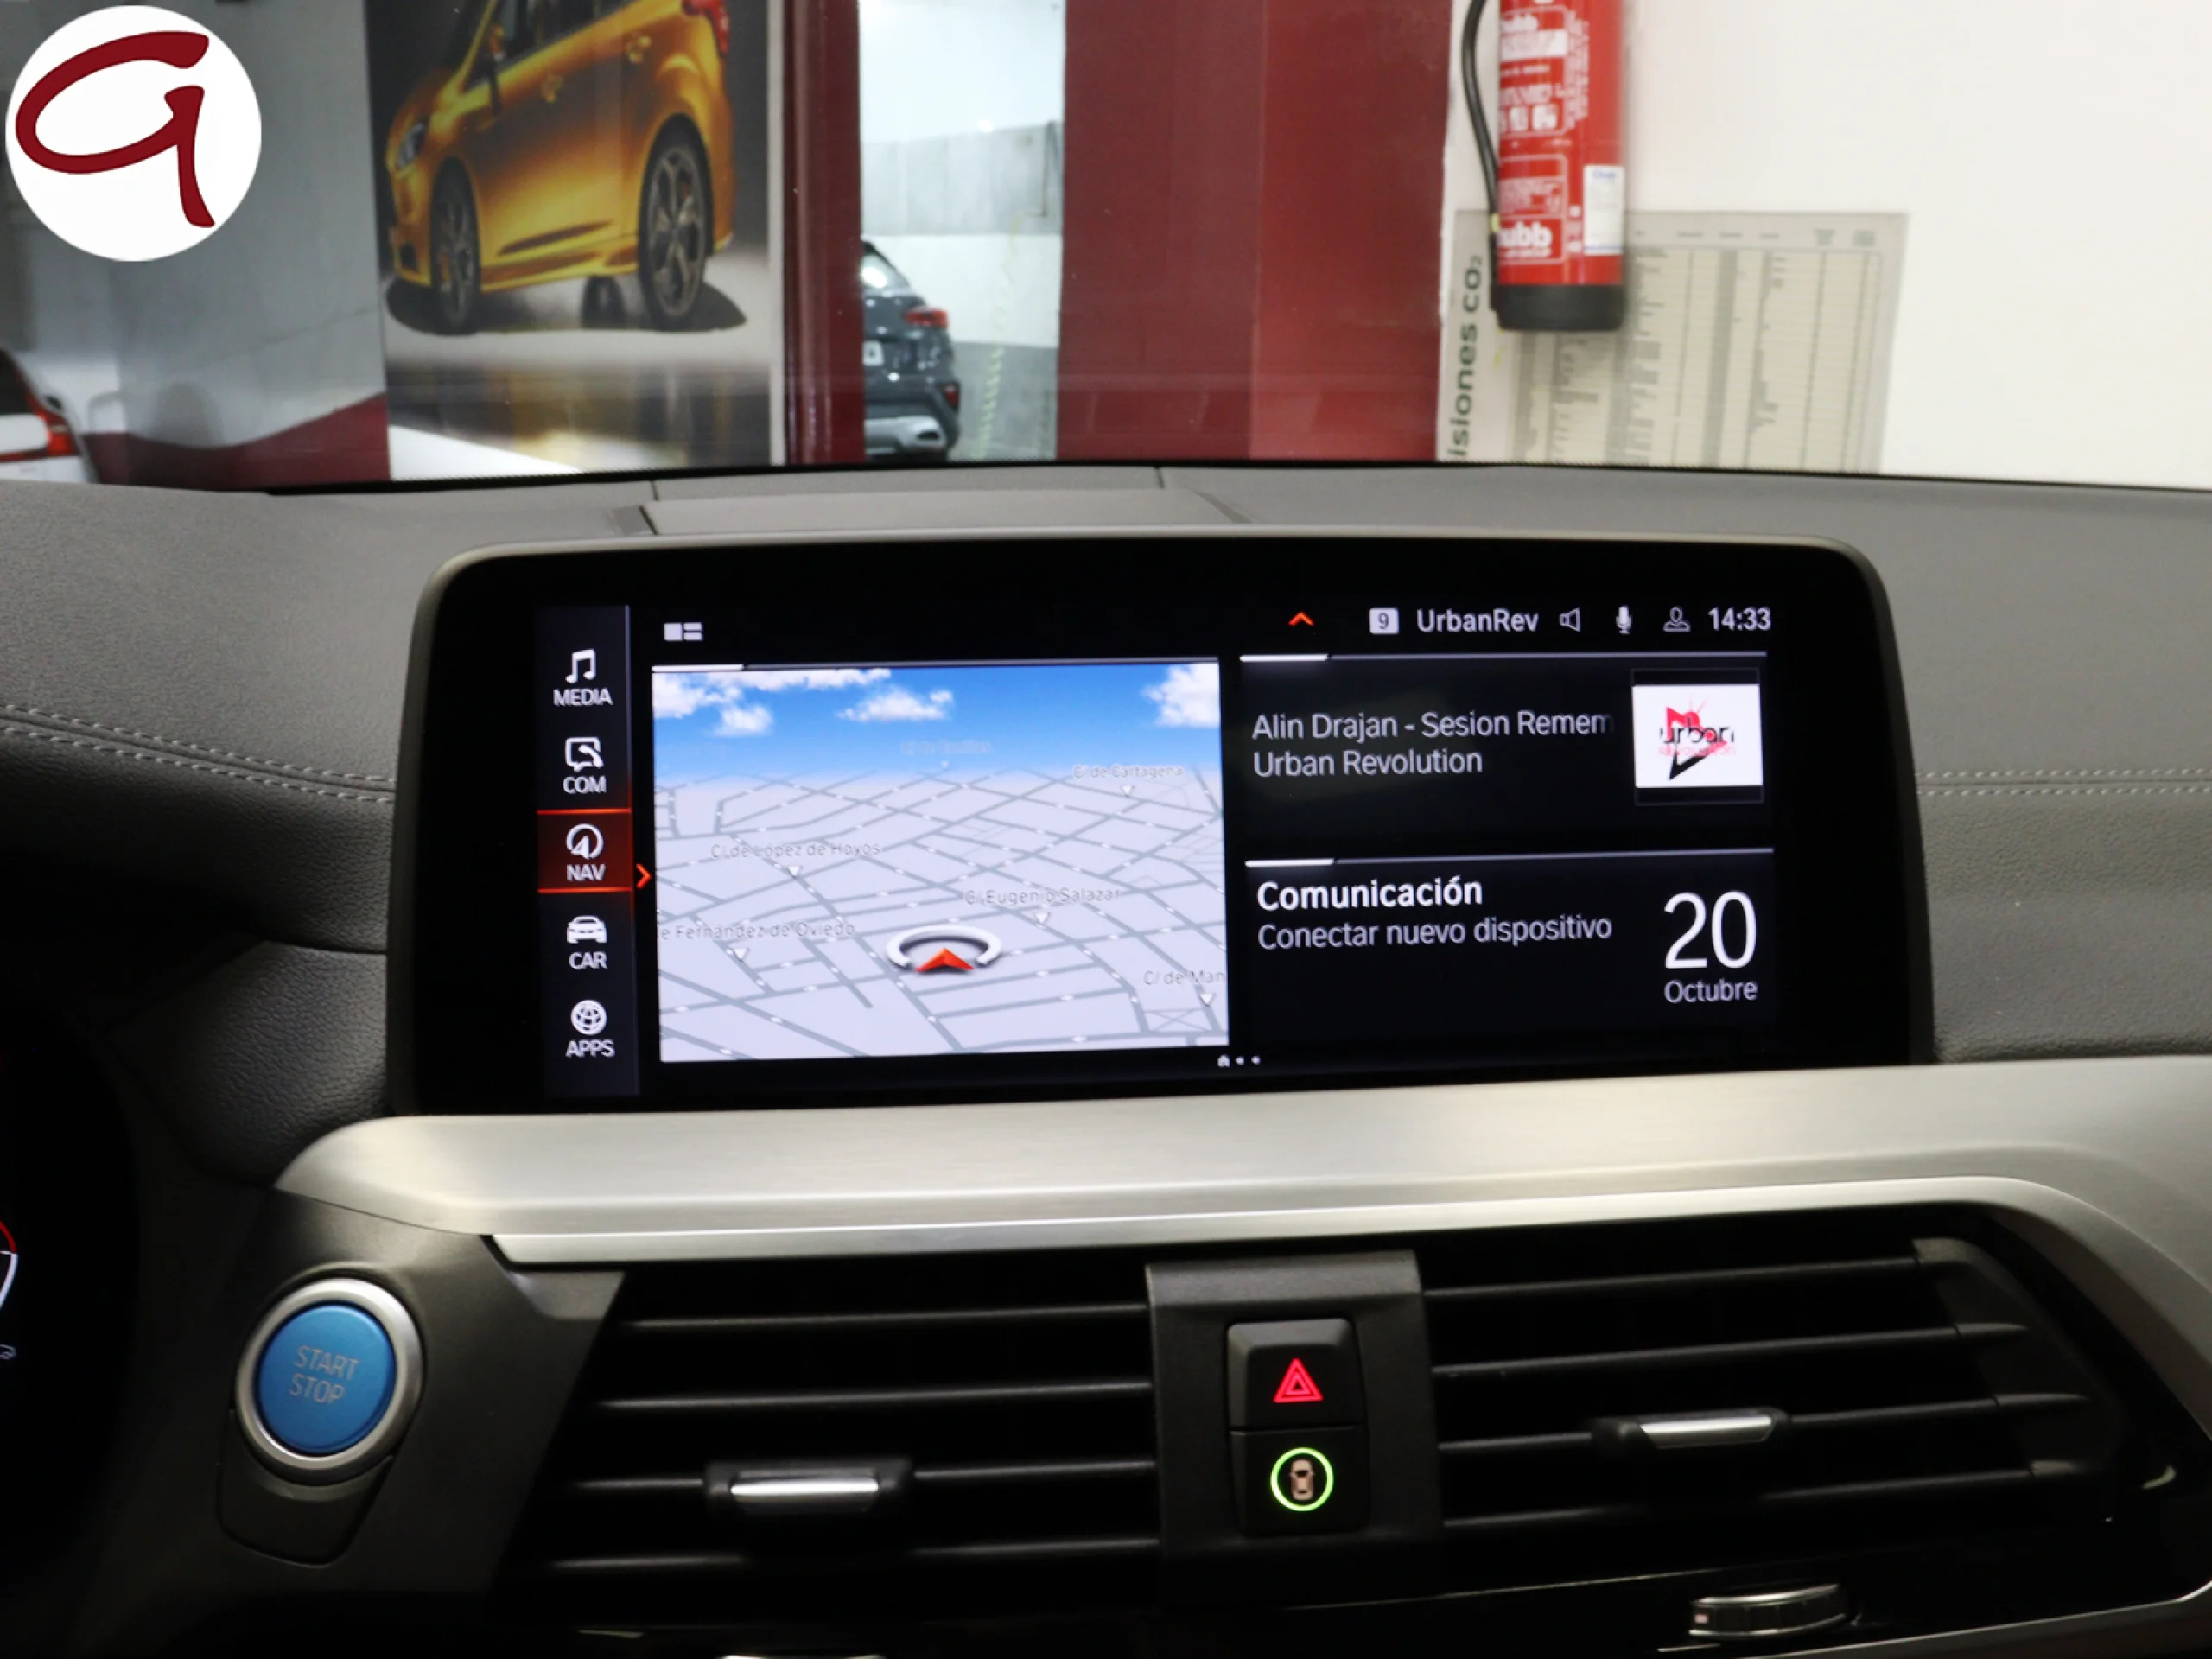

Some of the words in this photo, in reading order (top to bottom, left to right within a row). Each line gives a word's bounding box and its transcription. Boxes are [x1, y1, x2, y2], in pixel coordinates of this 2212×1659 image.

[1376, 611, 1389, 631] 9
[1416, 607, 1540, 633] UrbanRev
[1707, 607, 1771, 632] 14:33
[553, 687, 614, 707] MEDIA
[1251, 714, 1304, 741] Alin
[1312, 712, 1399, 744] Drajan
[1421, 710, 1510, 737] Sesion
[1253, 751, 1335, 778] Urban
[1343, 747, 1483, 774] Revolution
[563, 775, 607, 794] COM
[566, 863, 607, 882] NAV
[1257, 875, 1484, 911] Comunicación
[1257, 921, 1378, 950] Conectar
[1386, 924, 1466, 945] nuevo
[1473, 914, 1613, 947] dispositivo
[1664, 890, 1758, 969] 20
[569, 950, 607, 969] CAR
[1664, 978, 1758, 1003] Octubre
[566, 1039, 615, 1058] APPS
[294, 1344, 361, 1381] START
[288, 1372, 346, 1405] STOP
